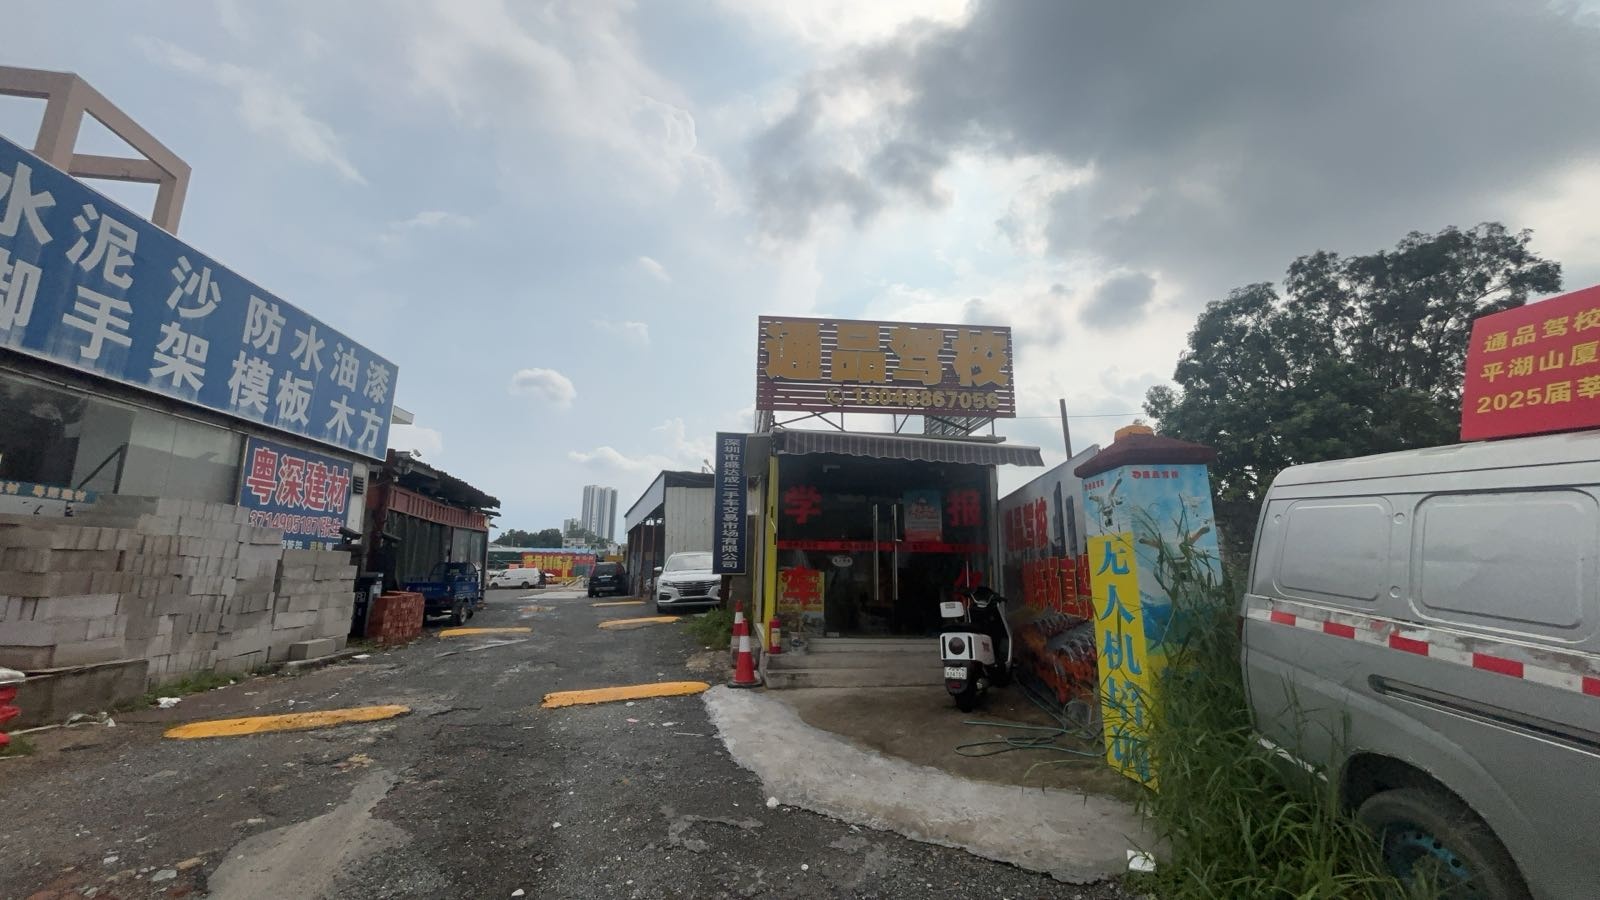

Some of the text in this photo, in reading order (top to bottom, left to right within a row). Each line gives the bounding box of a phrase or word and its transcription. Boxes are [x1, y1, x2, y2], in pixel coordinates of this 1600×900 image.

[0, 162, 390, 404] 水泥 沙 防水油漆
[764, 322, 1010, 387] 通品驾校
[1480, 340, 1600, 383] 平湖山厦
[1483, 308, 1600, 354] 通品驾校
[228, 350, 314, 428] 模板
[326, 394, 384, 449] 木方
[851, 387, 999, 410] 13048867056
[246, 447, 350, 515] 粤深建材
